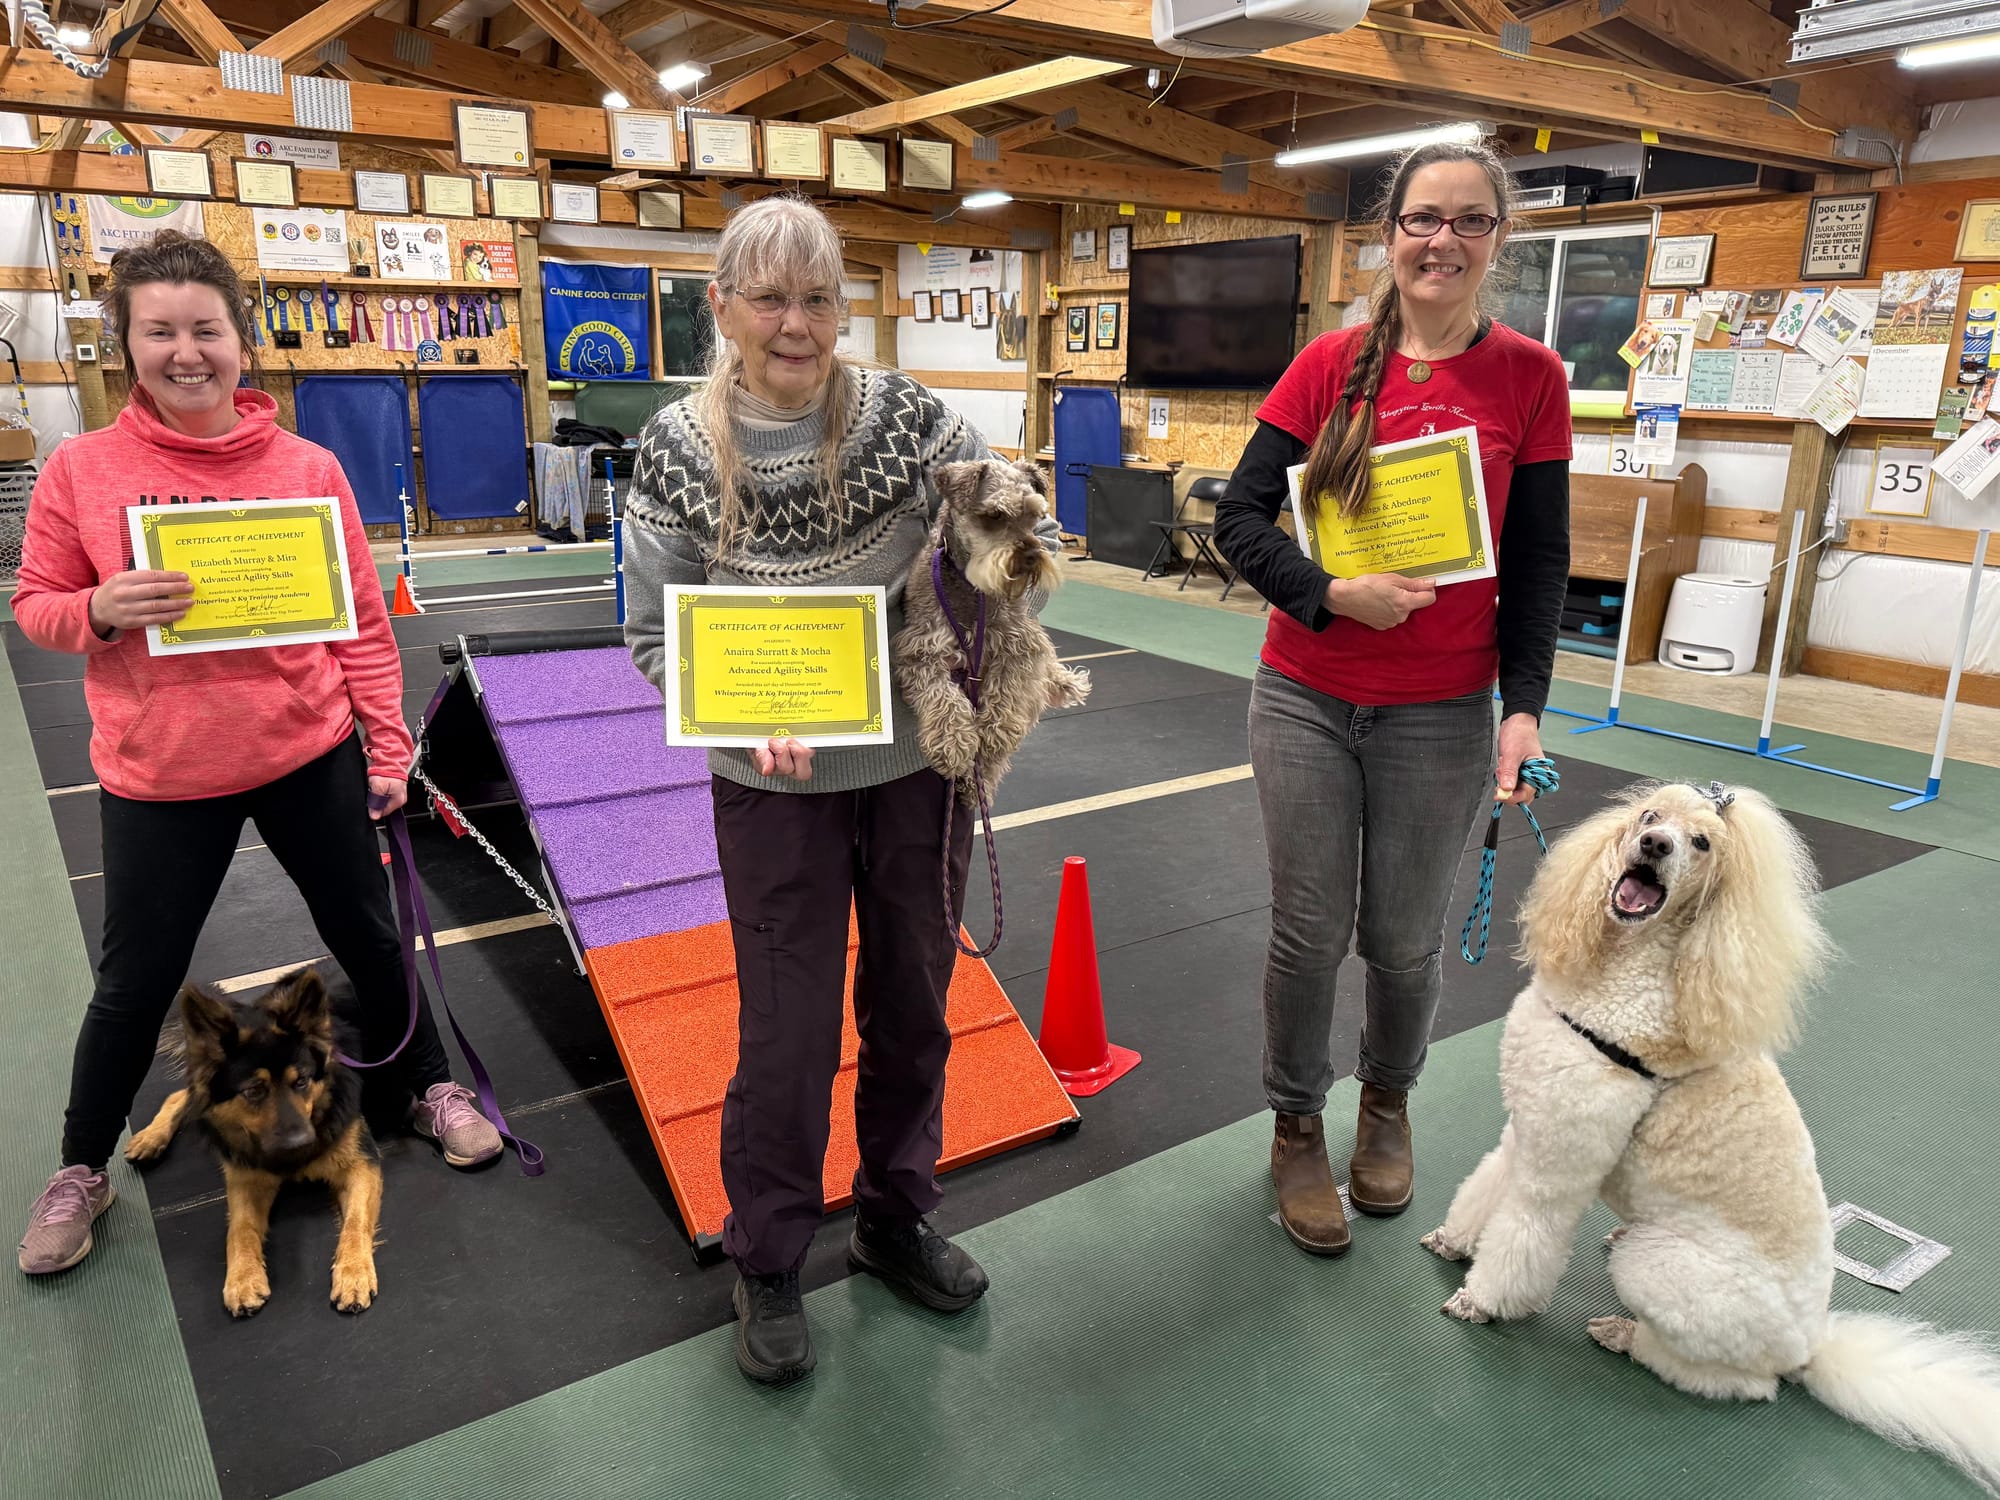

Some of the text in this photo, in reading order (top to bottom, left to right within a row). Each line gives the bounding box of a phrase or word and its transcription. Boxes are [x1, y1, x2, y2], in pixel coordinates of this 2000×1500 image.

[1818, 203, 1866, 214] DOG RULES
[100, 228, 120, 237] AKC
[123, 230, 140, 238] FIT
[1836, 223, 1864, 232] SOFTLY
[1812, 244, 1860, 254] FETCH
[550, 288, 583, 298] CANINE
[584, 291, 610, 299] GOOD
[561, 322, 634, 371] CANINE GOOD CITIZEN
[1151, 408, 1166, 426] 15
[1385, 469, 1441, 486] ACHIEVEMENT
[1880, 464, 1923, 492] 35
[1391, 496, 1432, 510] Abednego
[1344, 522, 1379, 536] Advanced
[1382, 518, 1407, 528] Agility
[1408, 513, 1430, 522] Skills
[176, 536, 232, 546] CERTIFICATE
[247, 532, 305, 541] ACHIEVEMENT
[1336, 546, 1368, 557] Whispering
[1386, 538, 1414, 548] Training
[1415, 532, 1446, 542] Academy
[190, 558, 232, 568] Elizabeth
[234, 556, 266, 566] Murray
[200, 575, 241, 584] Advanced
[243, 573, 270, 582] Agility
[194, 597, 230, 605] hispering
[248, 593, 278, 601] Training
[724, 648, 754, 656] Anaira
[756, 648, 788, 656] Surratt
[801, 647, 831, 656] Mocha
[774, 667, 802, 676] Agility
